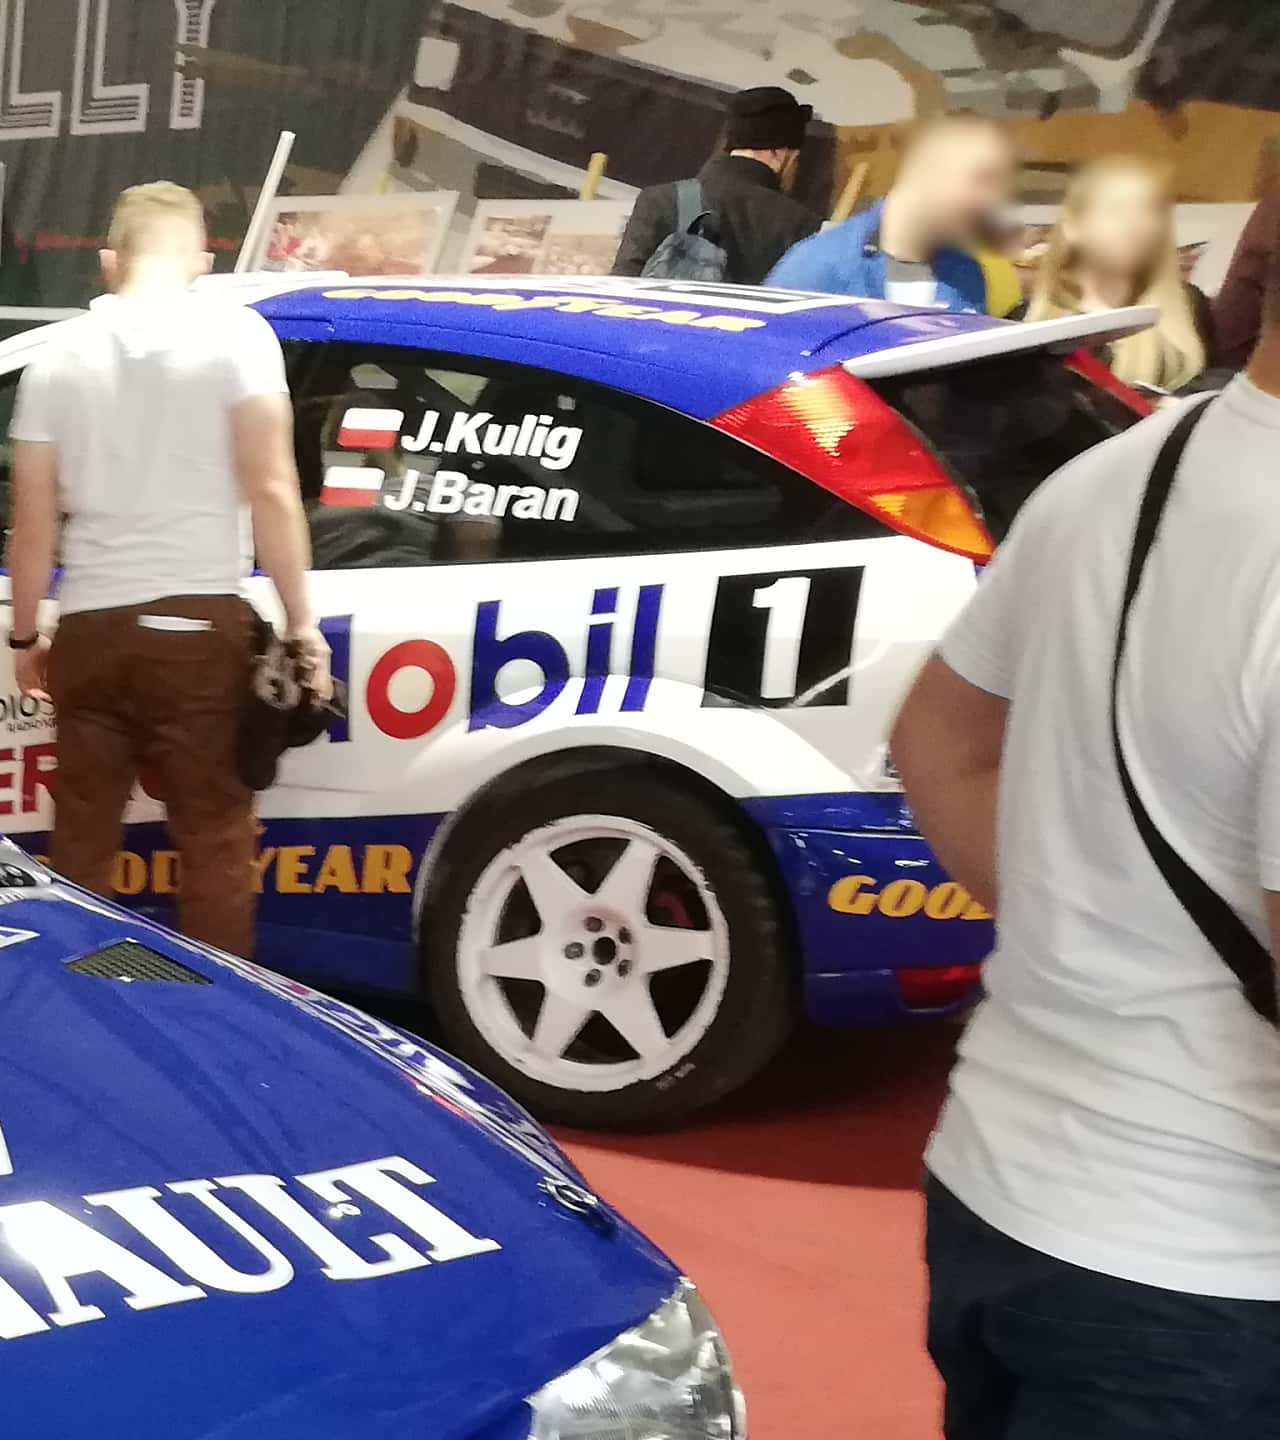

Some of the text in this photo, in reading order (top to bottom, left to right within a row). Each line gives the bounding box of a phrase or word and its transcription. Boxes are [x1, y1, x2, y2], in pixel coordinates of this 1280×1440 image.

[399, 408, 583, 470] J.Kulig
[383, 468, 580, 523] J.Baran
[319, 575, 813, 745] obil 1
